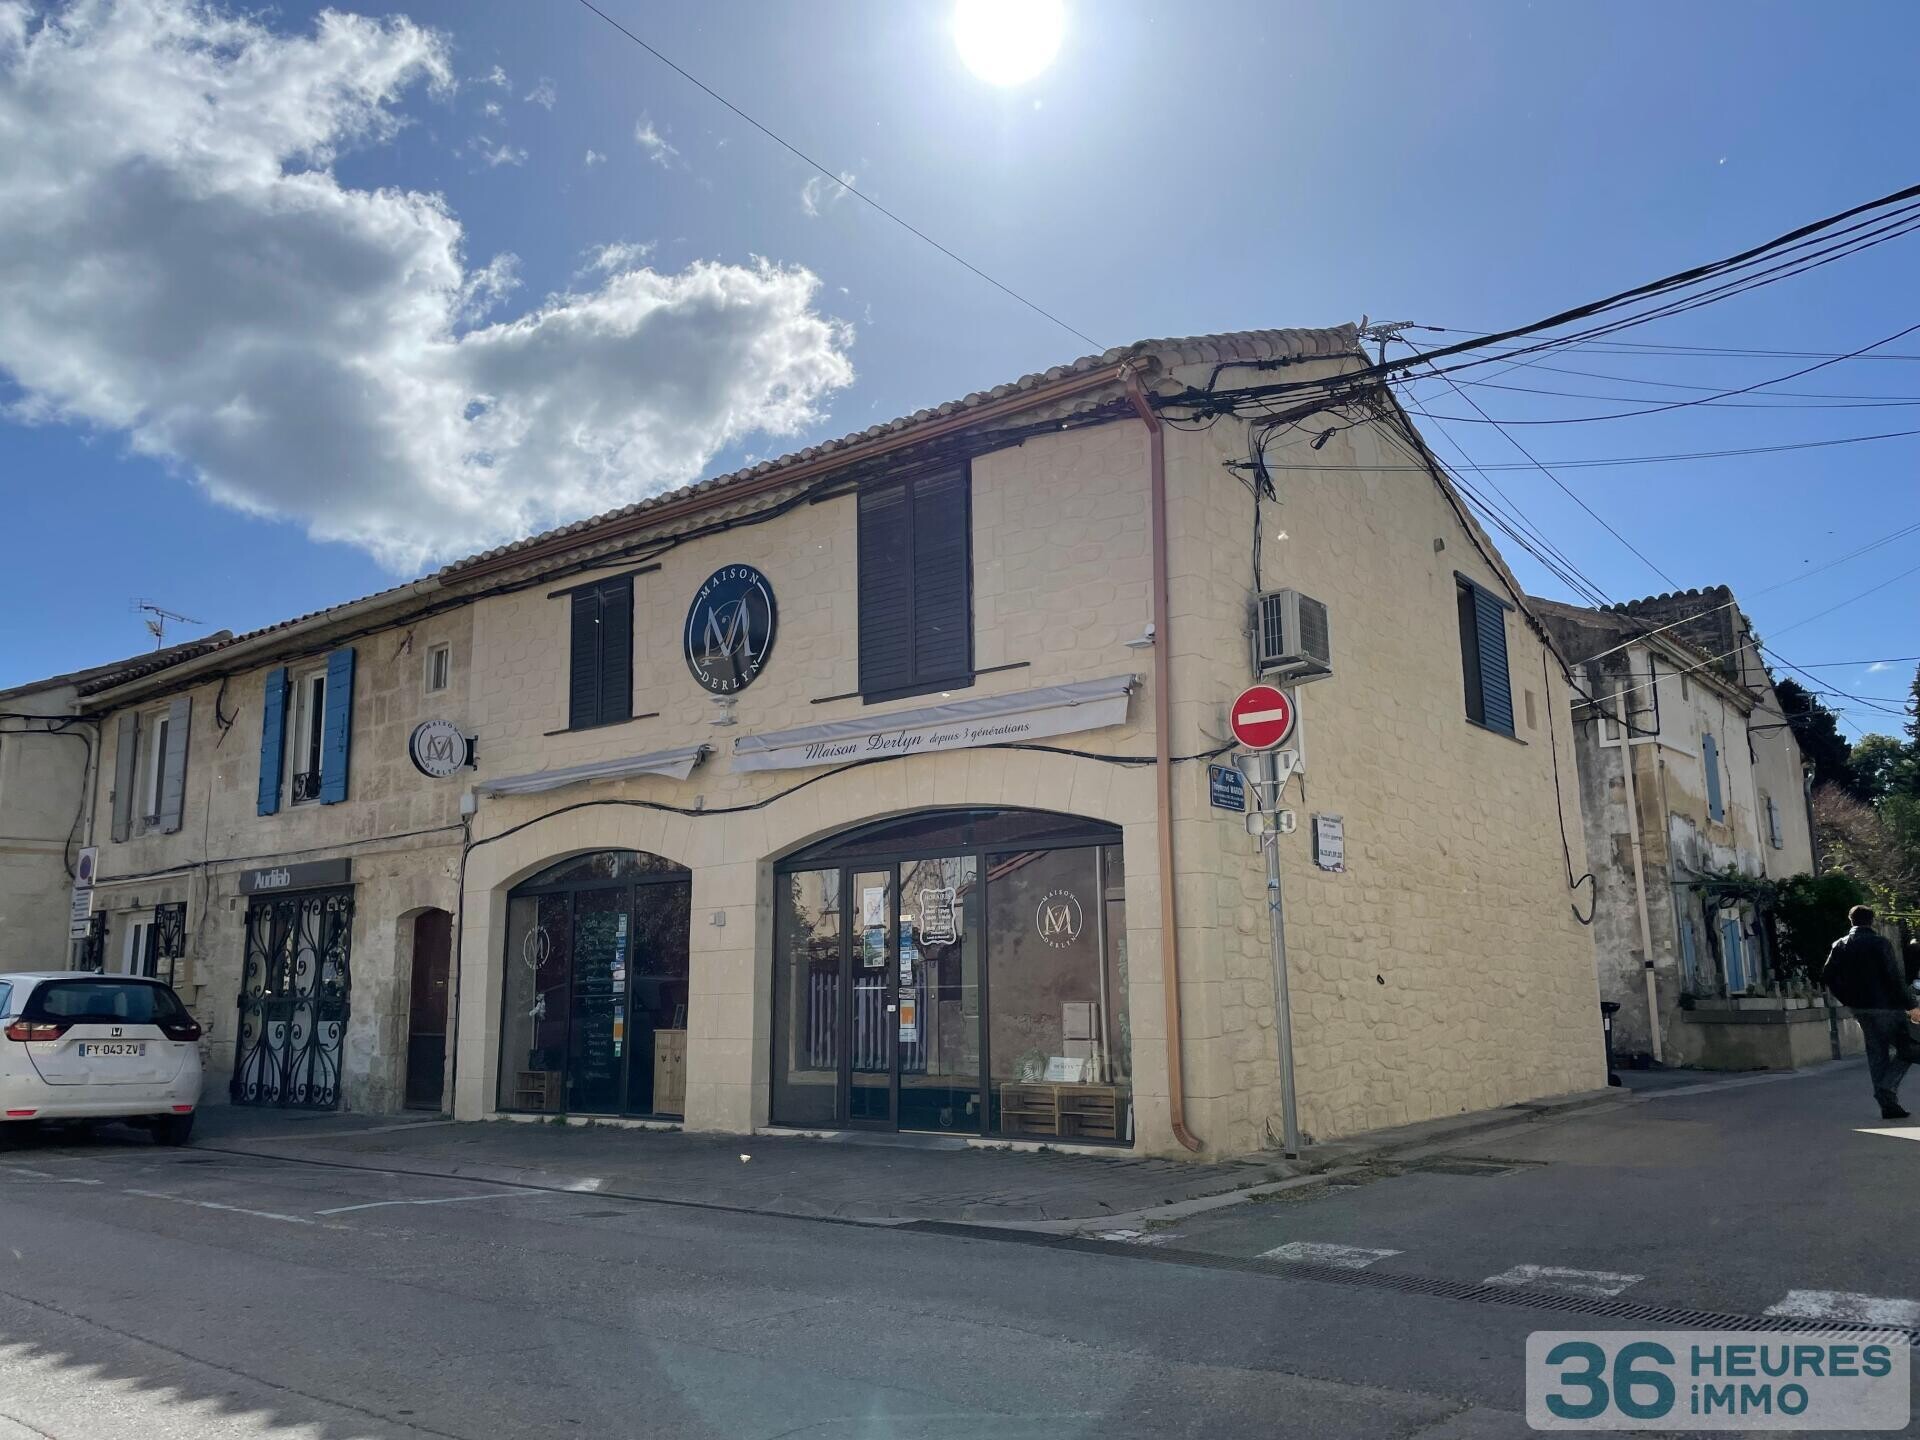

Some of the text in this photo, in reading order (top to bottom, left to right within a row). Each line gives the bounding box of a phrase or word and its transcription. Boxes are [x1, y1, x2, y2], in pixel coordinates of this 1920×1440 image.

[701, 568, 759, 599] MAISON
[701, 659, 760, 690] DERLYN
[425, 721, 458, 732] MAISON
[805, 719, 1030, 759] Maison Derlyn depuis 3 générations
[254, 867, 290, 889] Audilab
[1042, 889, 1076, 902] MAISON
[1043, 935, 1077, 949] DERLYN
[86, 1044, 138, 1055] FY-043-ZV
